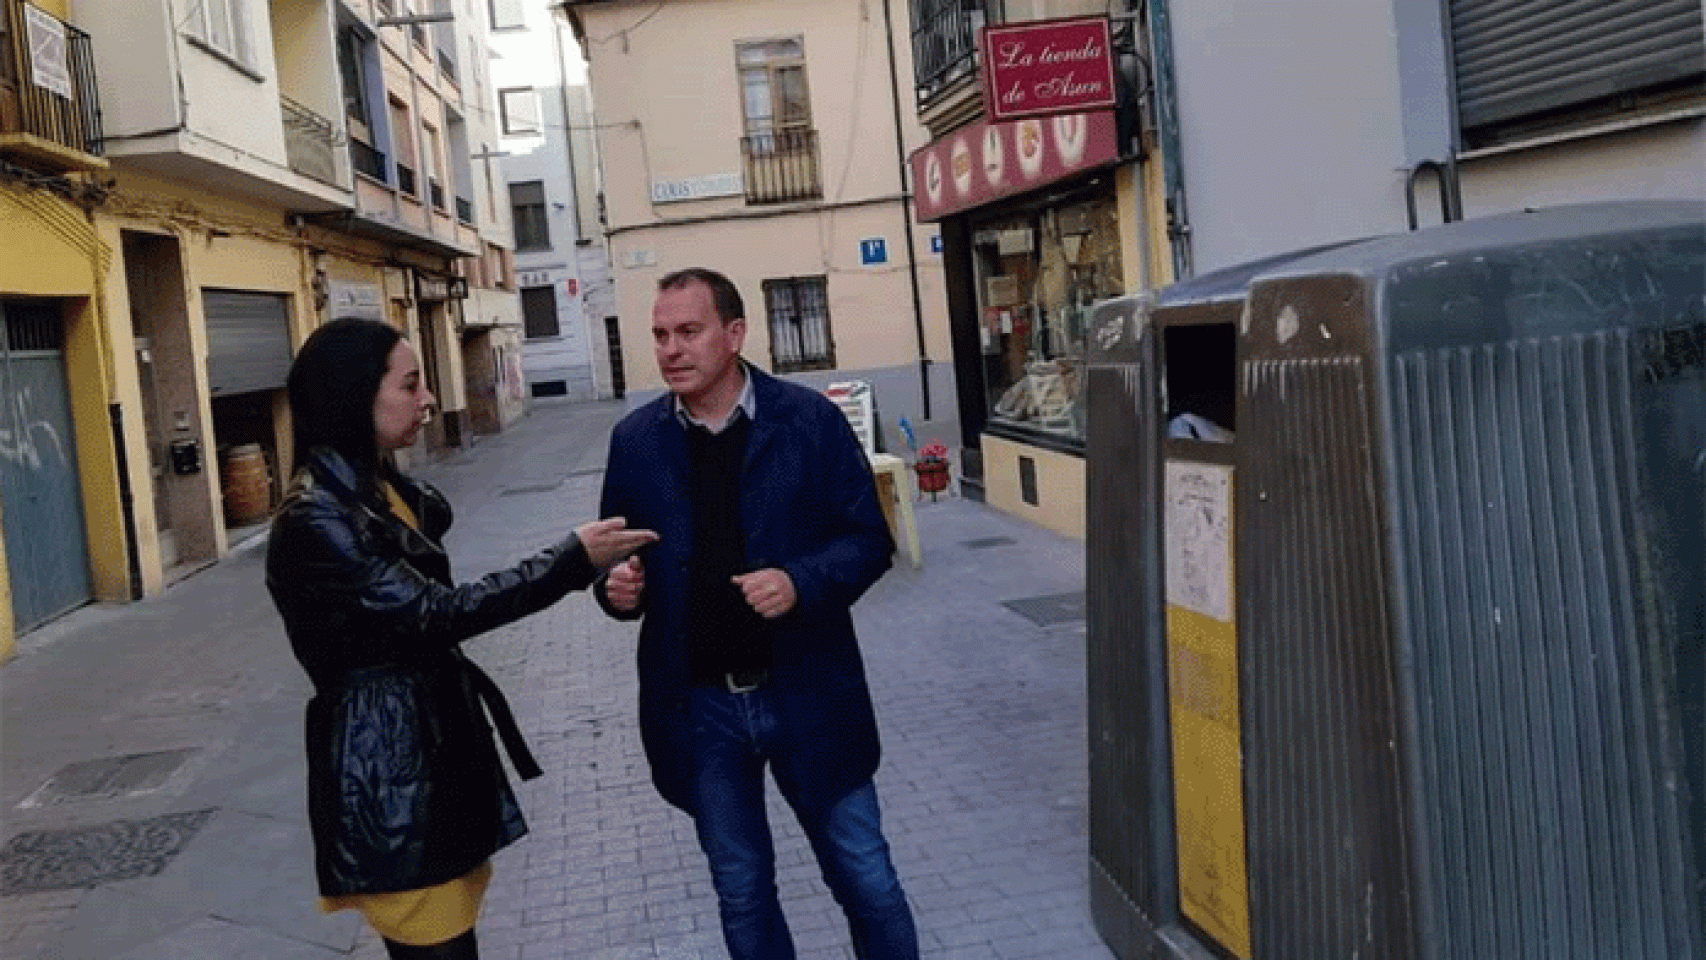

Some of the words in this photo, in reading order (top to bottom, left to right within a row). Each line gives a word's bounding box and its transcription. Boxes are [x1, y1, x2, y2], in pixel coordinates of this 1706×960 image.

[998, 41, 1032, 68] La
[1039, 36, 1102, 64] tienda
[1002, 80, 1025, 103] de
